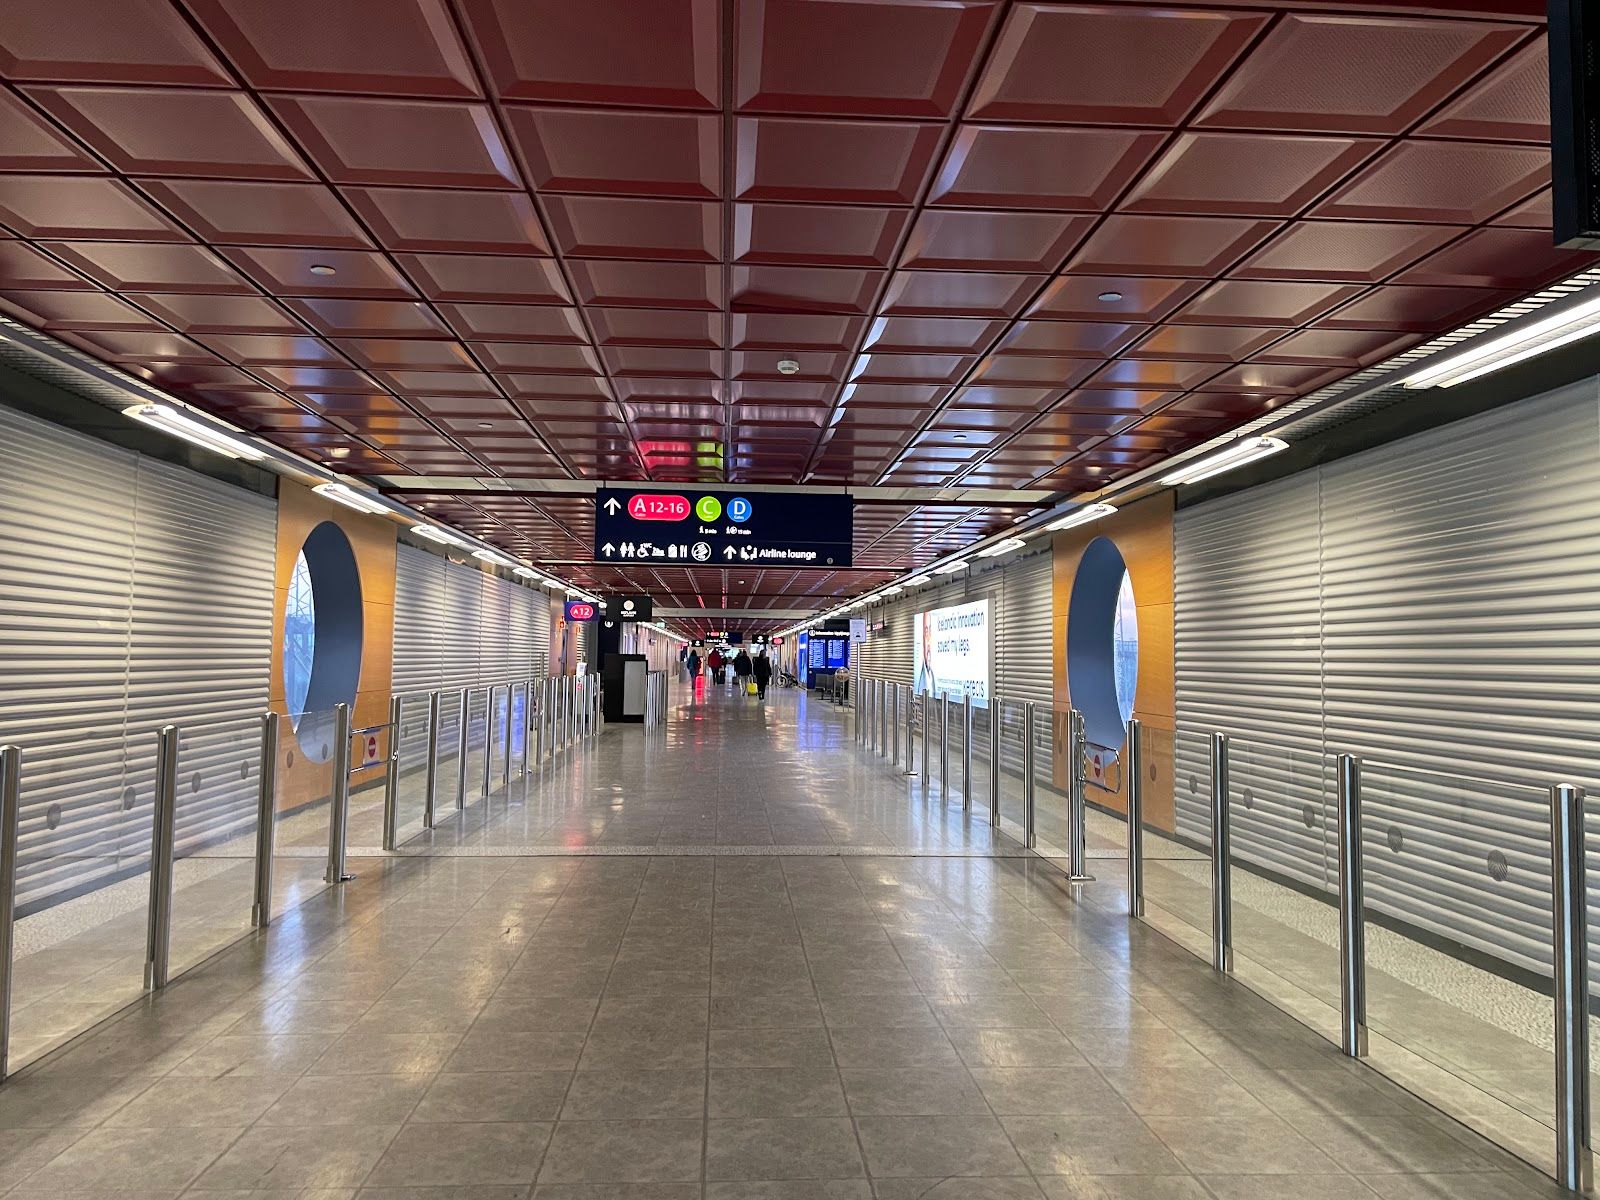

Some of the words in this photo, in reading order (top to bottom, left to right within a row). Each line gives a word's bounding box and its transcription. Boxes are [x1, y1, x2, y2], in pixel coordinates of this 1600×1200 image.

[633, 498, 647, 513] A
[649, 501, 685, 514] 12-16
[702, 500, 714, 515] C
[733, 500, 746, 515] D
[758, 548, 787, 558] Airline
[787, 549, 817, 561] lounge
[580, 607, 590, 616] 12
